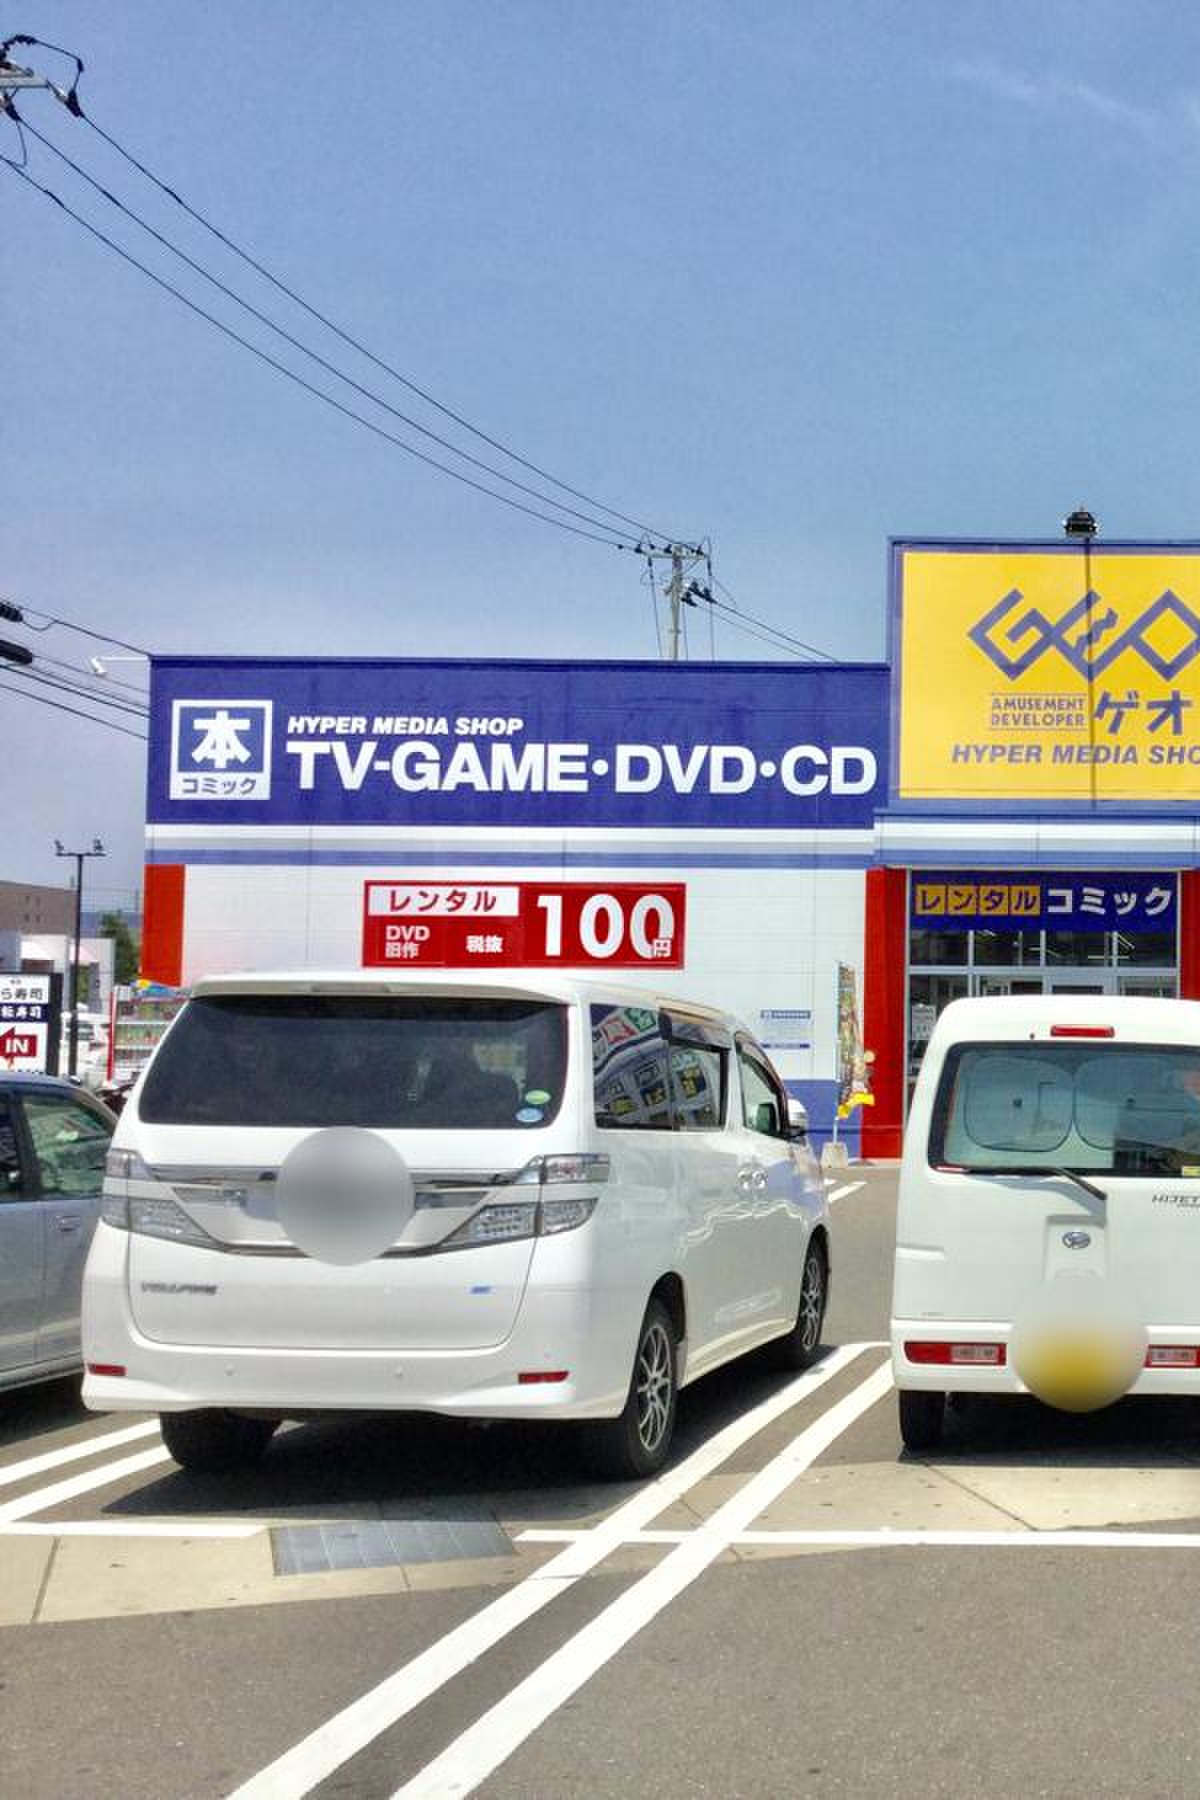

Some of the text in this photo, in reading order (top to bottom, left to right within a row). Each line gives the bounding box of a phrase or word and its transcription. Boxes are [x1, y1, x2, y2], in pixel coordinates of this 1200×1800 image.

[991, 698, 1085, 711] AMUSEMENT
[1093, 690, 1192, 735] ゲオ
[287, 716, 524, 736] HYPER MEDIA SHOP
[991, 712, 1086, 727] DEVELOPER
[191, 710, 251, 769] 本
[951, 744, 1043, 764] HYPER
[1051, 744, 1139, 765] MEDIA
[182, 777, 257, 796] コミック
[388, 889, 498, 913] レンタル
[385, 925, 431, 942] DVD
[384, 942, 420, 959] 旧作
[5, 1039, 30, 1055] IN
